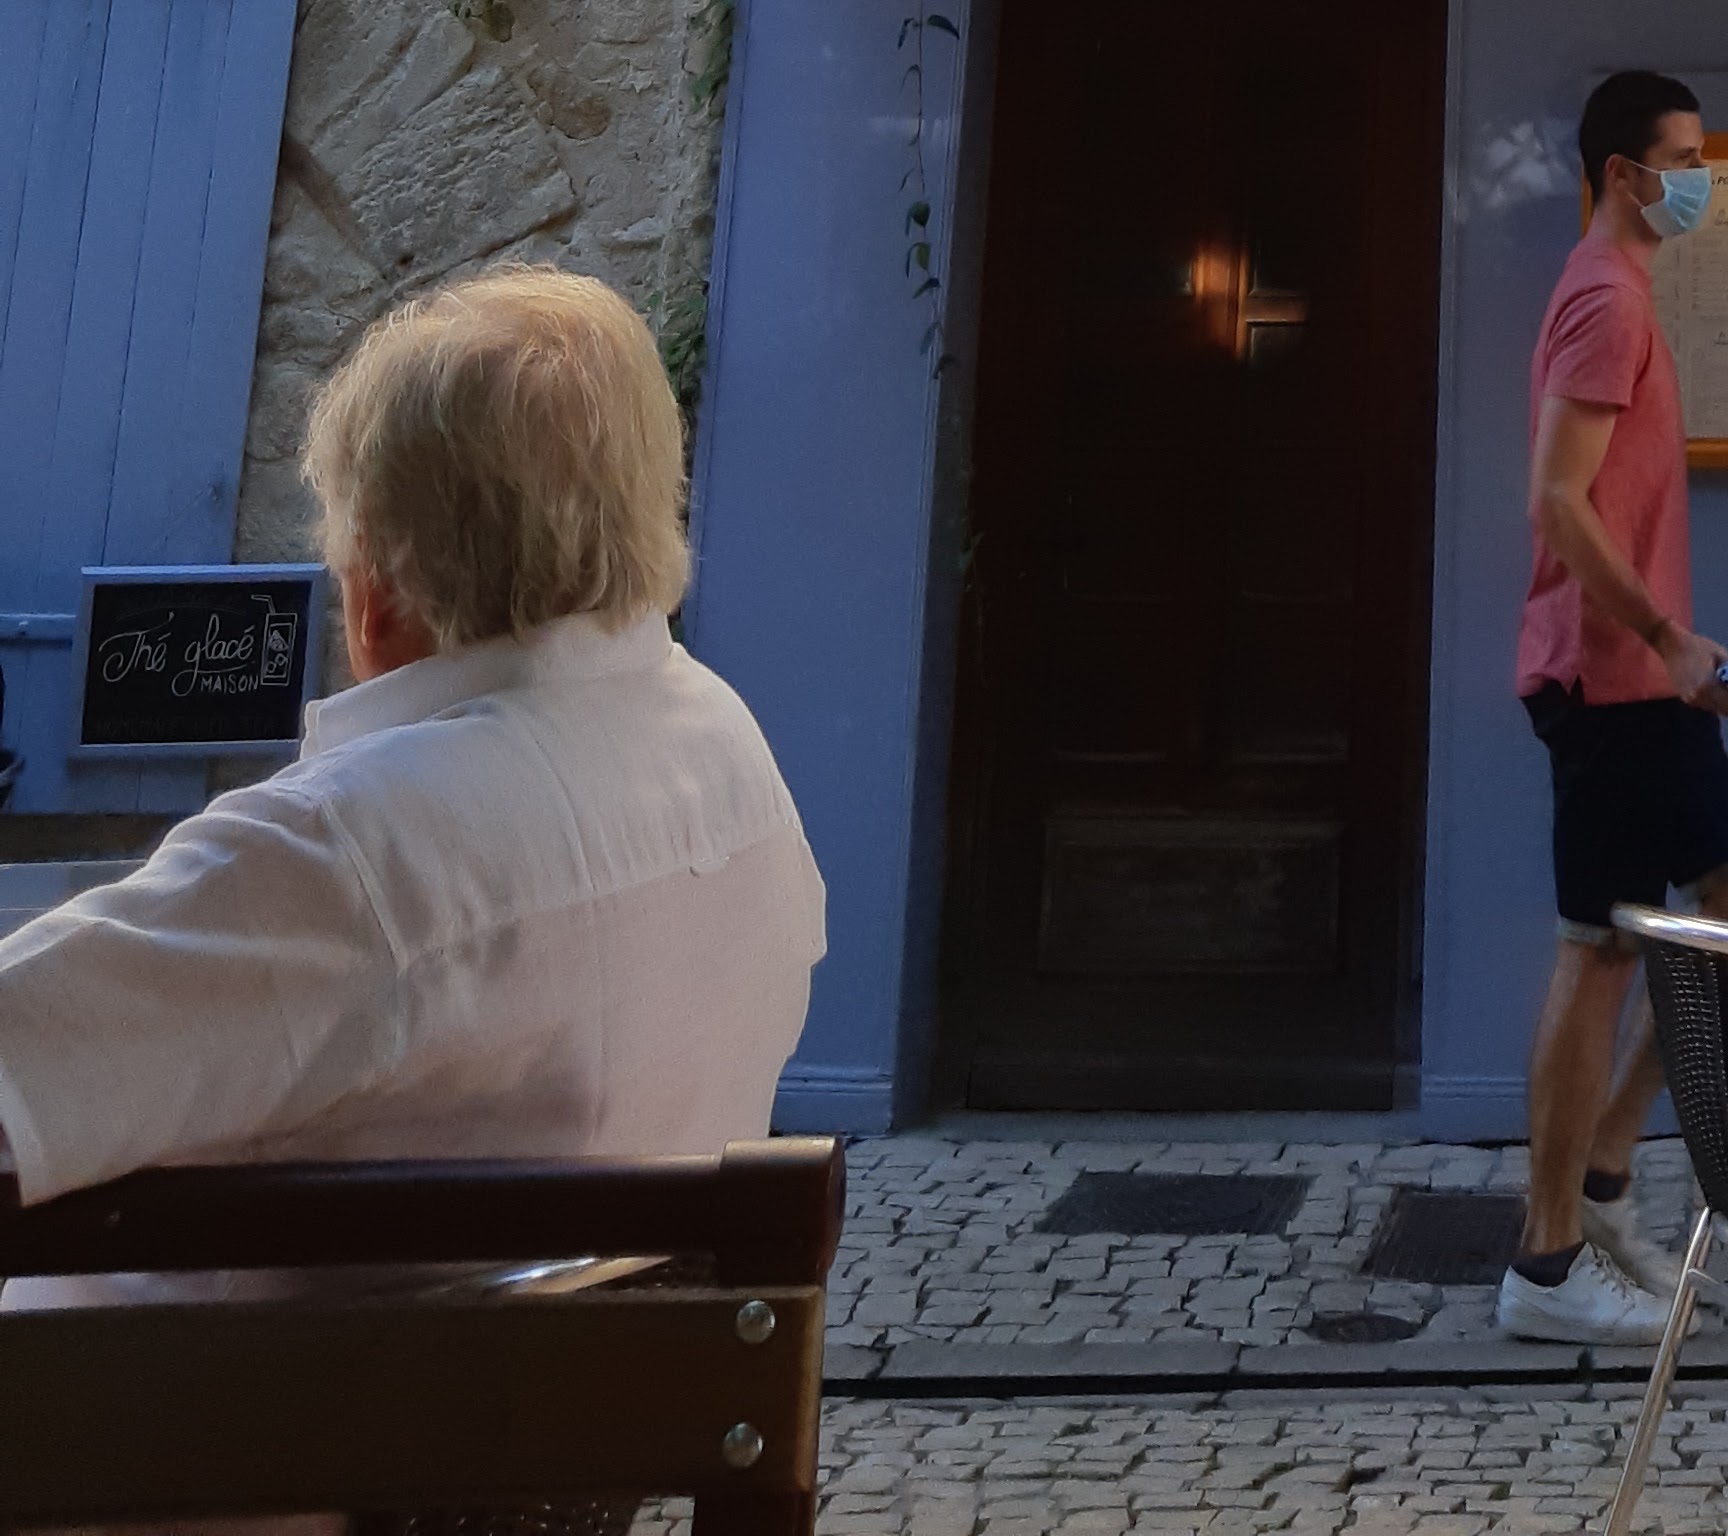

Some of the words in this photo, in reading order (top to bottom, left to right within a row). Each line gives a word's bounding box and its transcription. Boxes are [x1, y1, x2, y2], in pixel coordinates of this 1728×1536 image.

[98, 610, 175, 682] Thé
[171, 613, 256, 697] glacé
[200, 674, 260, 695] MAISON
